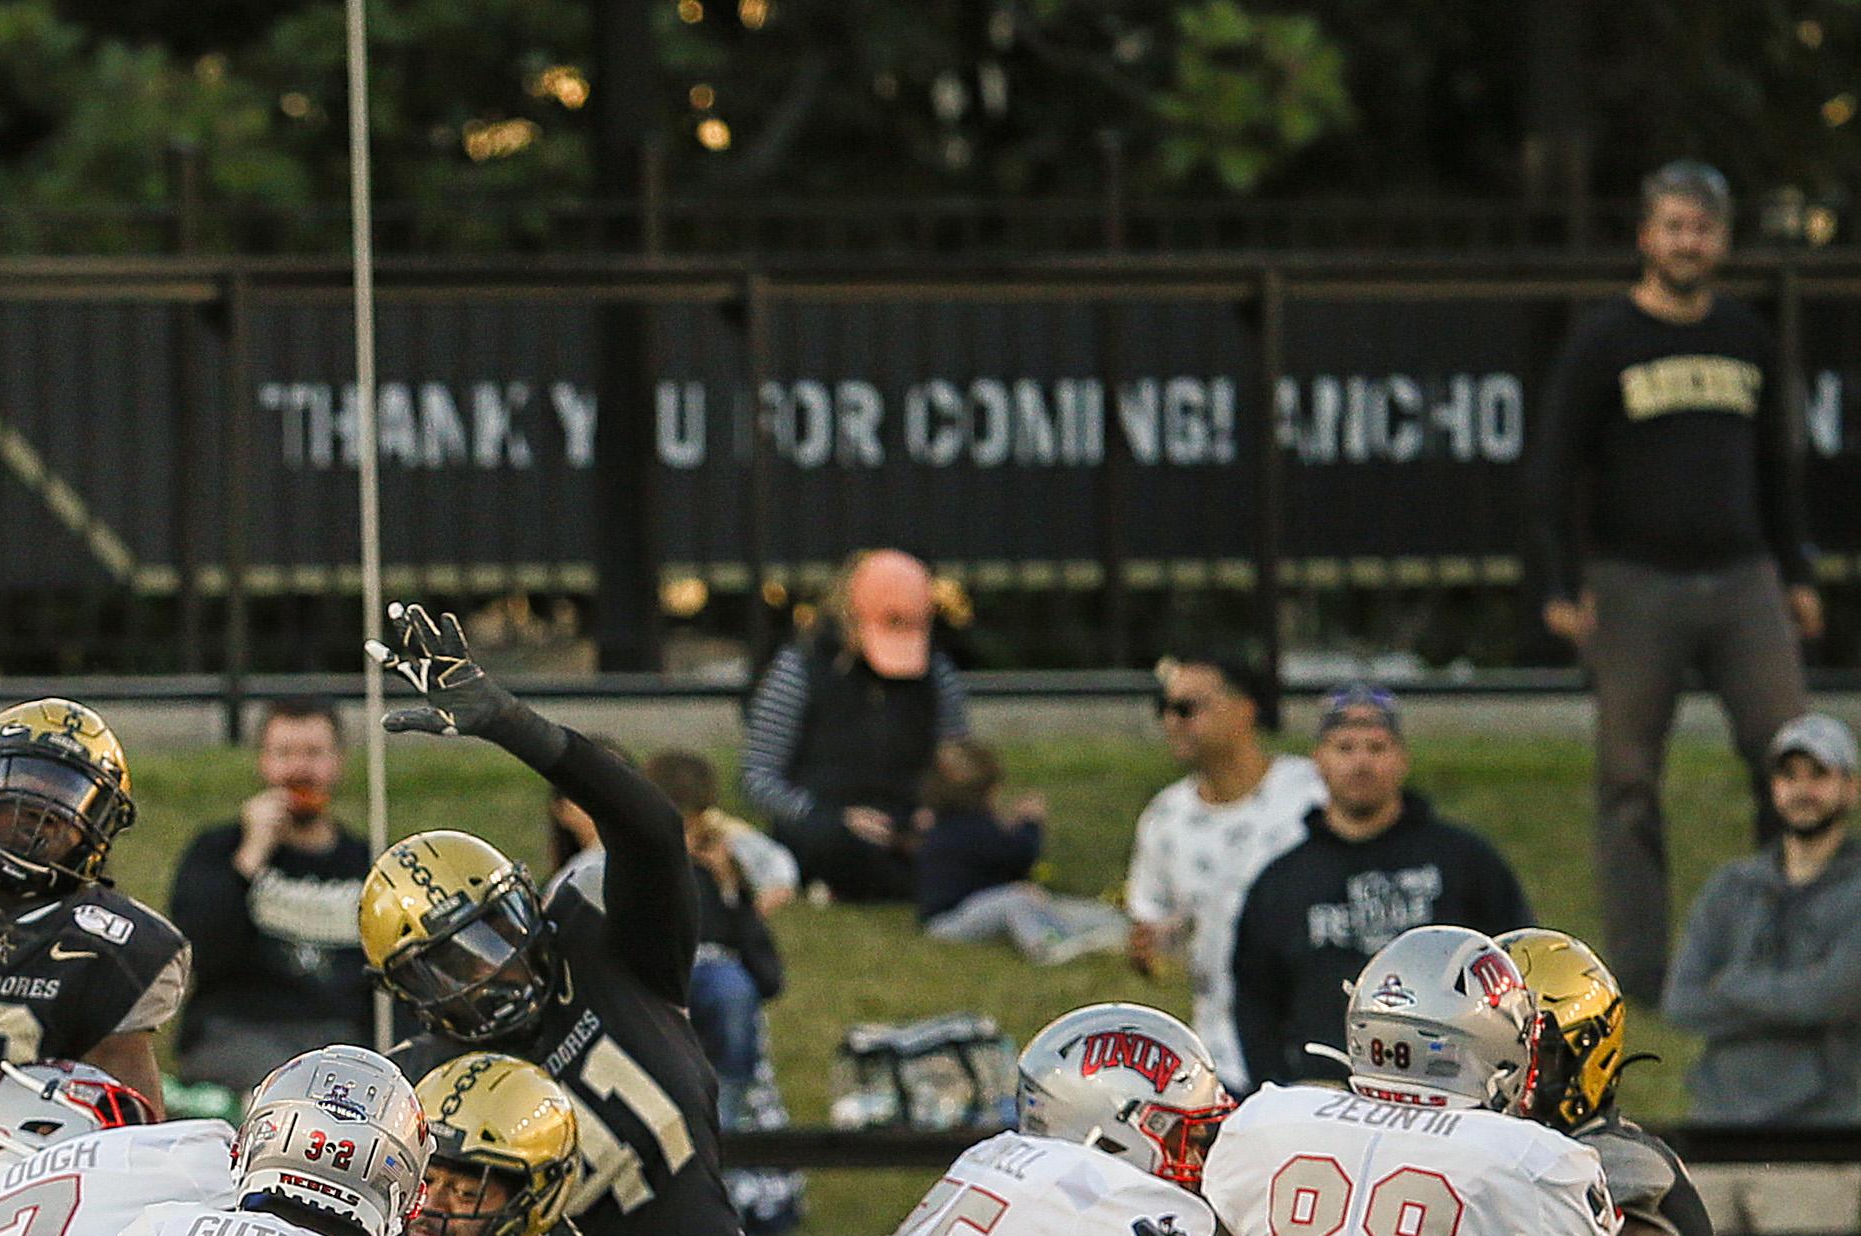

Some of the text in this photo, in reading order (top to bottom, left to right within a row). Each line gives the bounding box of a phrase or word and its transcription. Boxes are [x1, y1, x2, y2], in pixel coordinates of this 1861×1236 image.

[548, 380, 707, 470] YU
[1273, 372, 1524, 465] ANCHO
[1081, 1031, 1182, 1094] UNLV
[560, 1033, 696, 1219] 41
[1314, 1096, 1419, 1131] ZEON
[280, 1173, 361, 1206] REBELS
